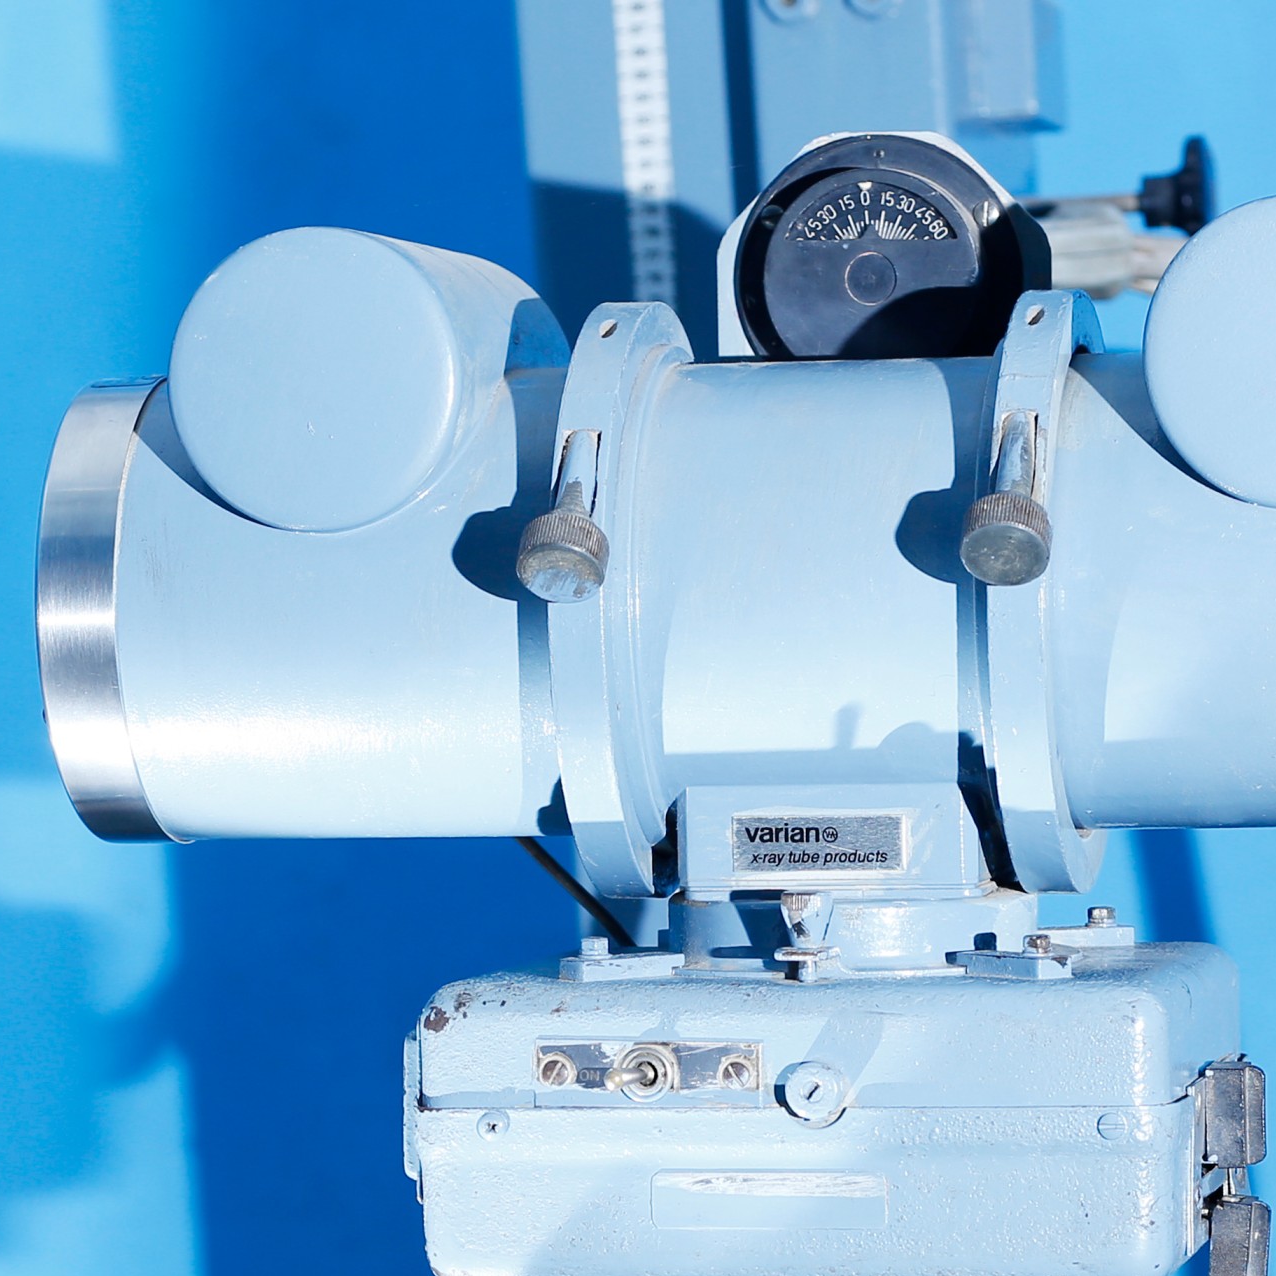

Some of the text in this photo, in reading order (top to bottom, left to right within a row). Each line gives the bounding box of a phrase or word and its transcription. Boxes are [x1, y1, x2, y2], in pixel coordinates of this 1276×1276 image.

[804, 190, 949, 240] 45 30 15 0 15 30 45 60
[744, 822, 821, 843] varian
[749, 849, 889, 867] x-ray tube products
[578, 1069, 600, 1082] ON
